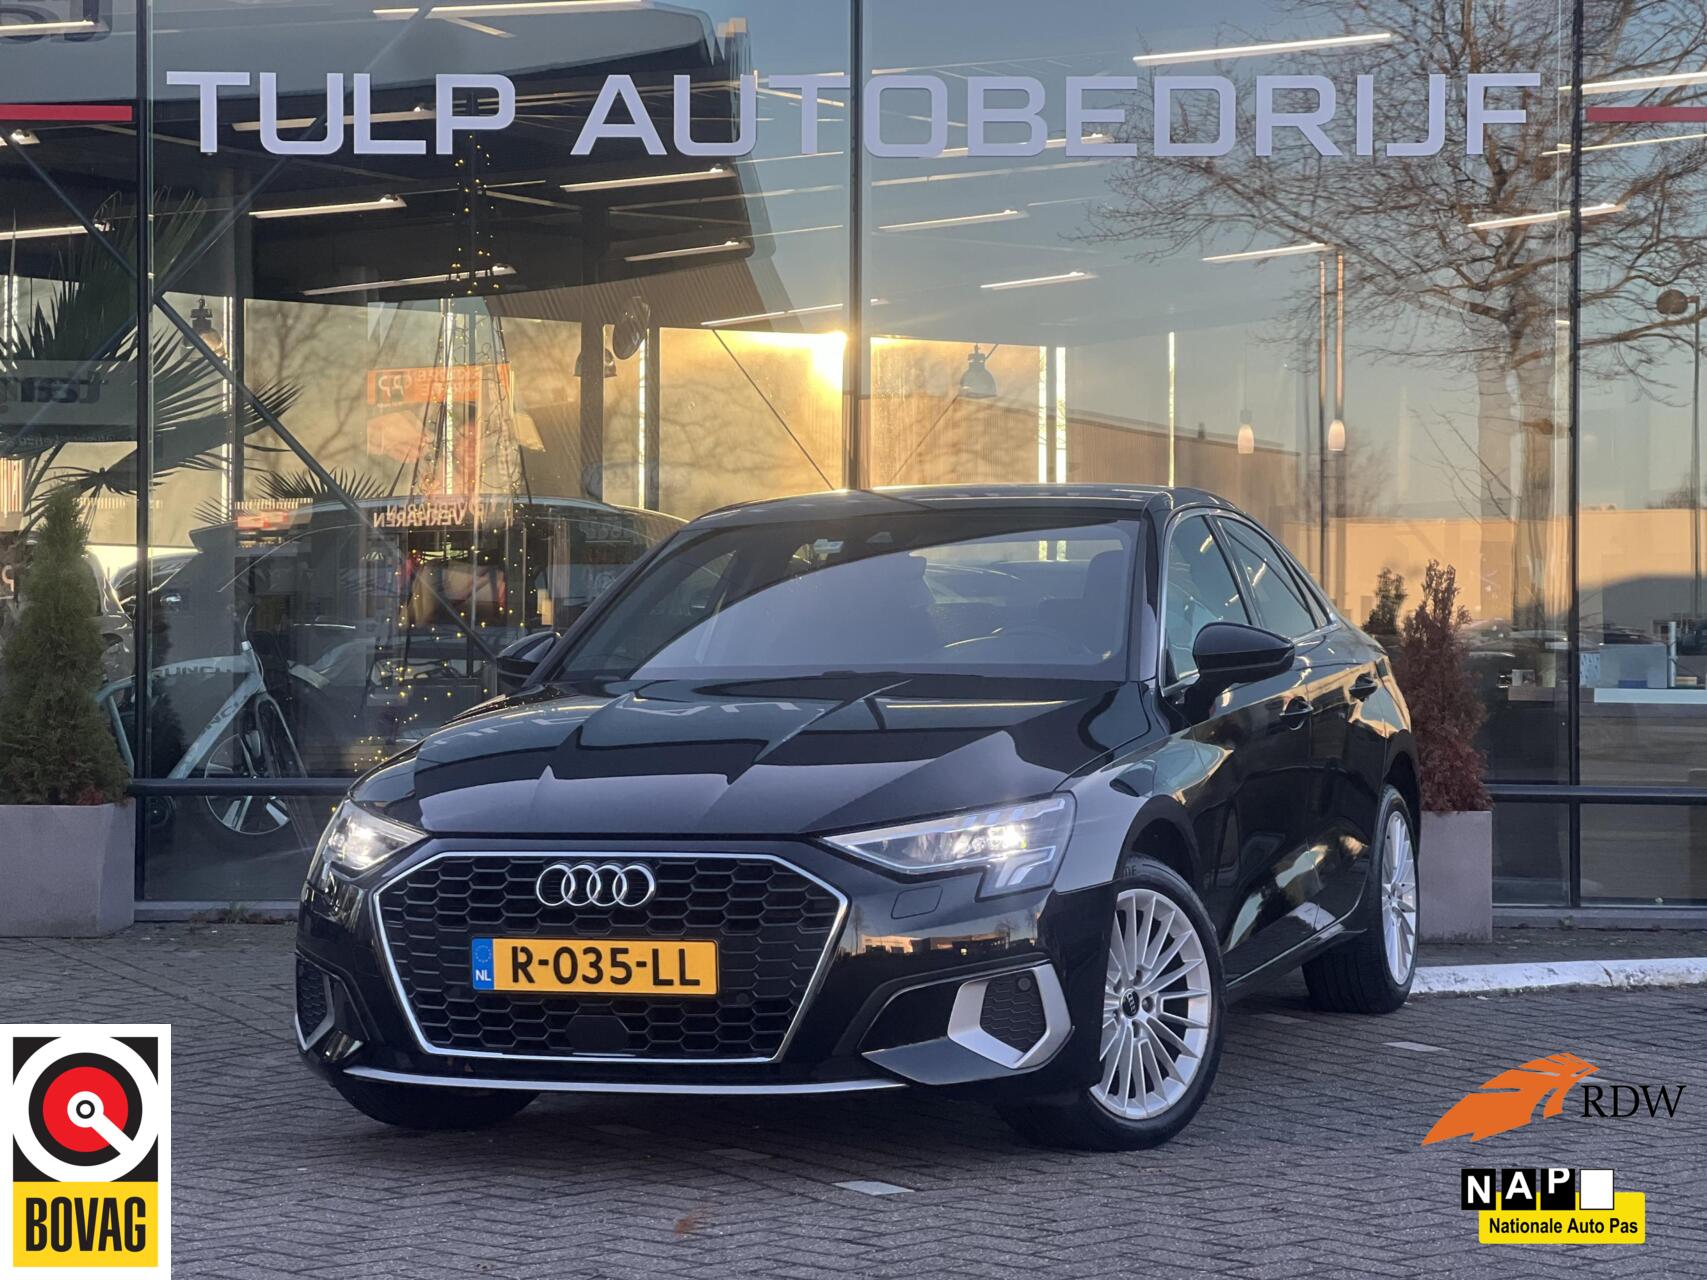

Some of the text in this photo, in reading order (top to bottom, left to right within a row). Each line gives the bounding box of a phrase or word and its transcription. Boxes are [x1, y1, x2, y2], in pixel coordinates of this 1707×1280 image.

[166, 71, 1541, 157] TULP AUTOBEDRIJF
[475, 969, 492, 982] NL
[511, 945, 701, 986] R-035-LL
